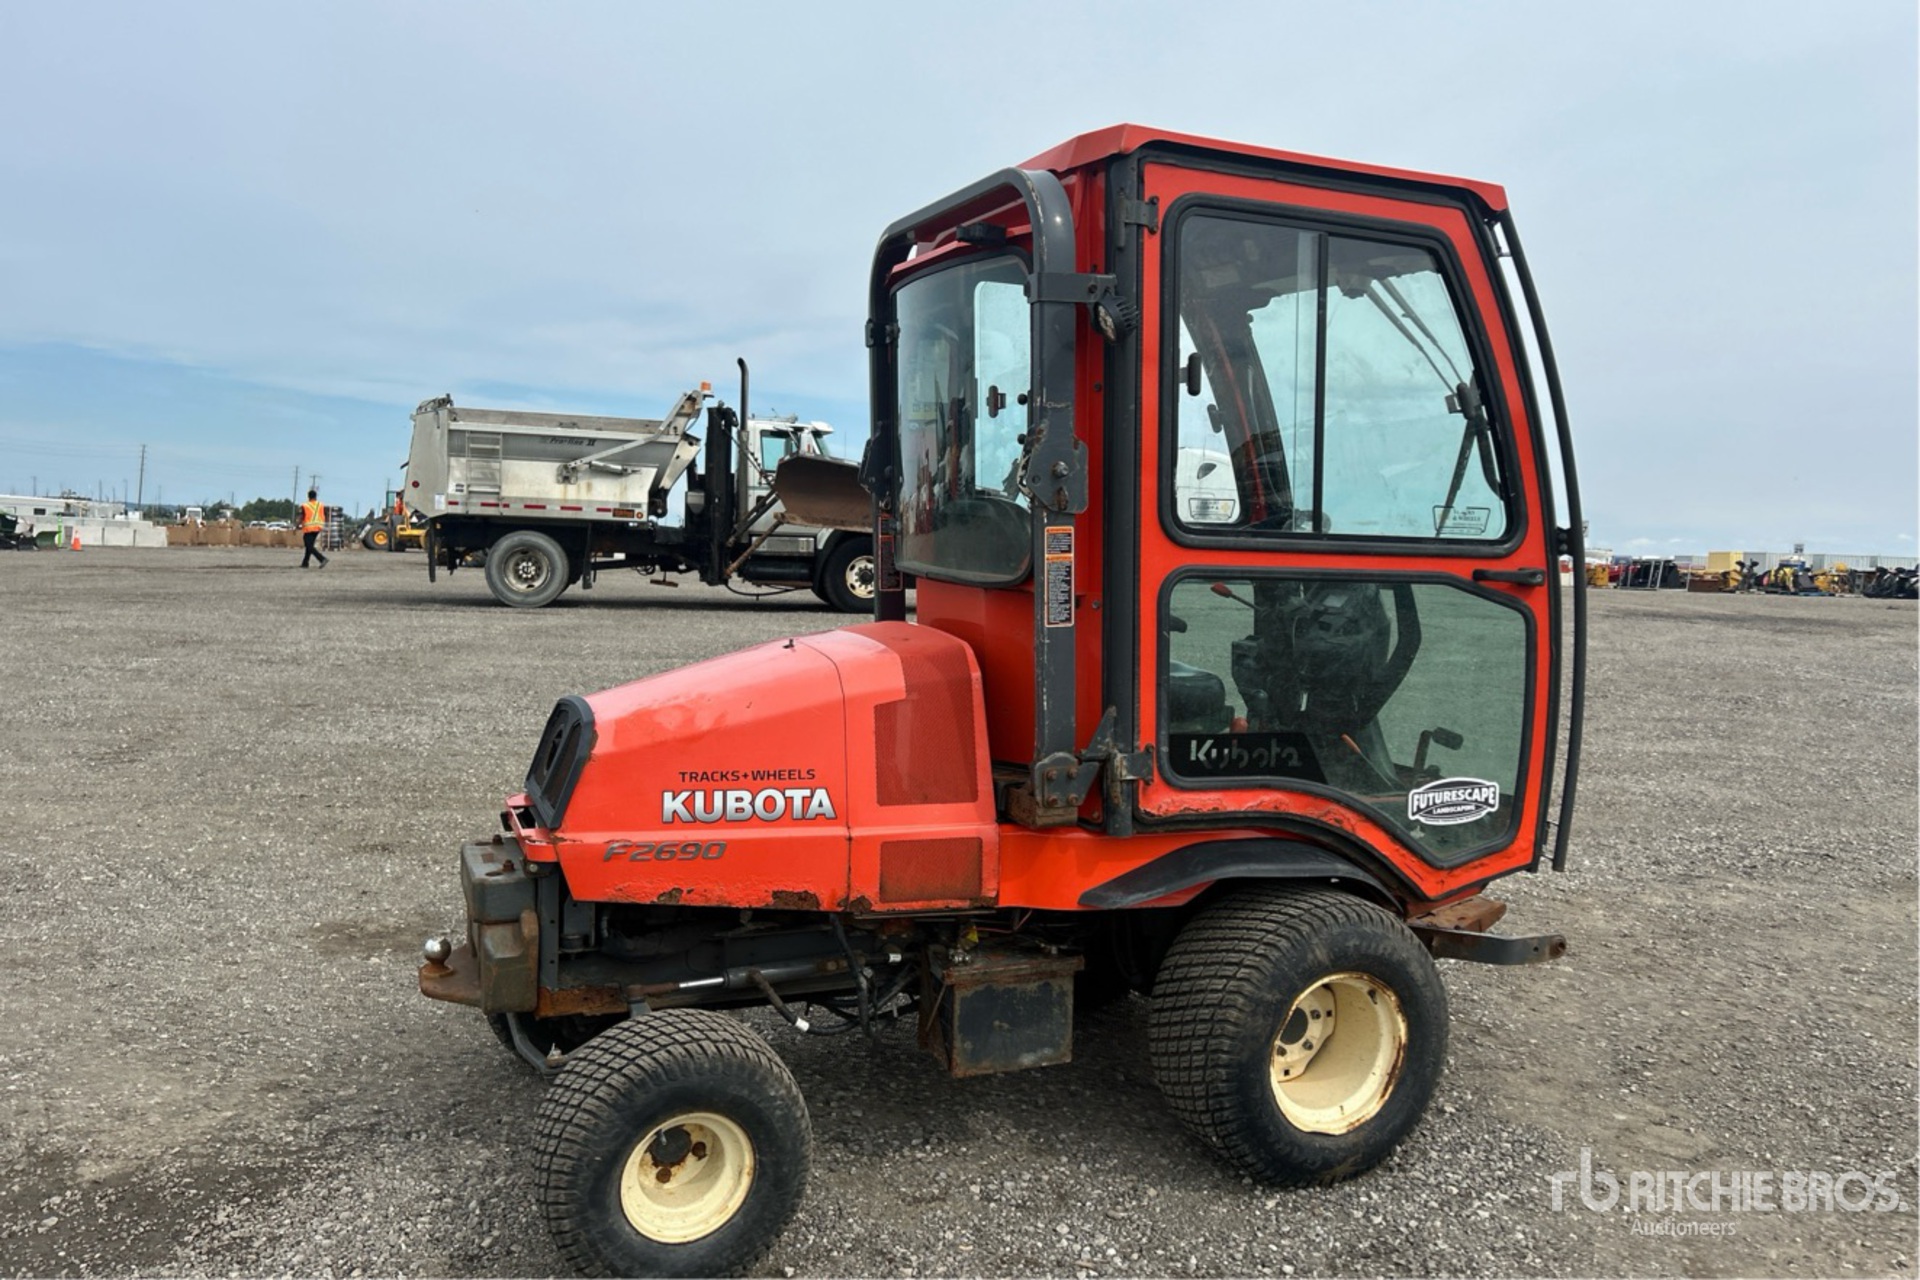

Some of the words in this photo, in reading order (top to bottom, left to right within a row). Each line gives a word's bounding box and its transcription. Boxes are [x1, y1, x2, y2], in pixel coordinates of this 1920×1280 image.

[1190, 738, 1303, 769] Kubota
[662, 787, 837, 824] KUBOTA
[1413, 787, 1496, 814] FUTURESCAPE
[603, 840, 727, 862] F2690
